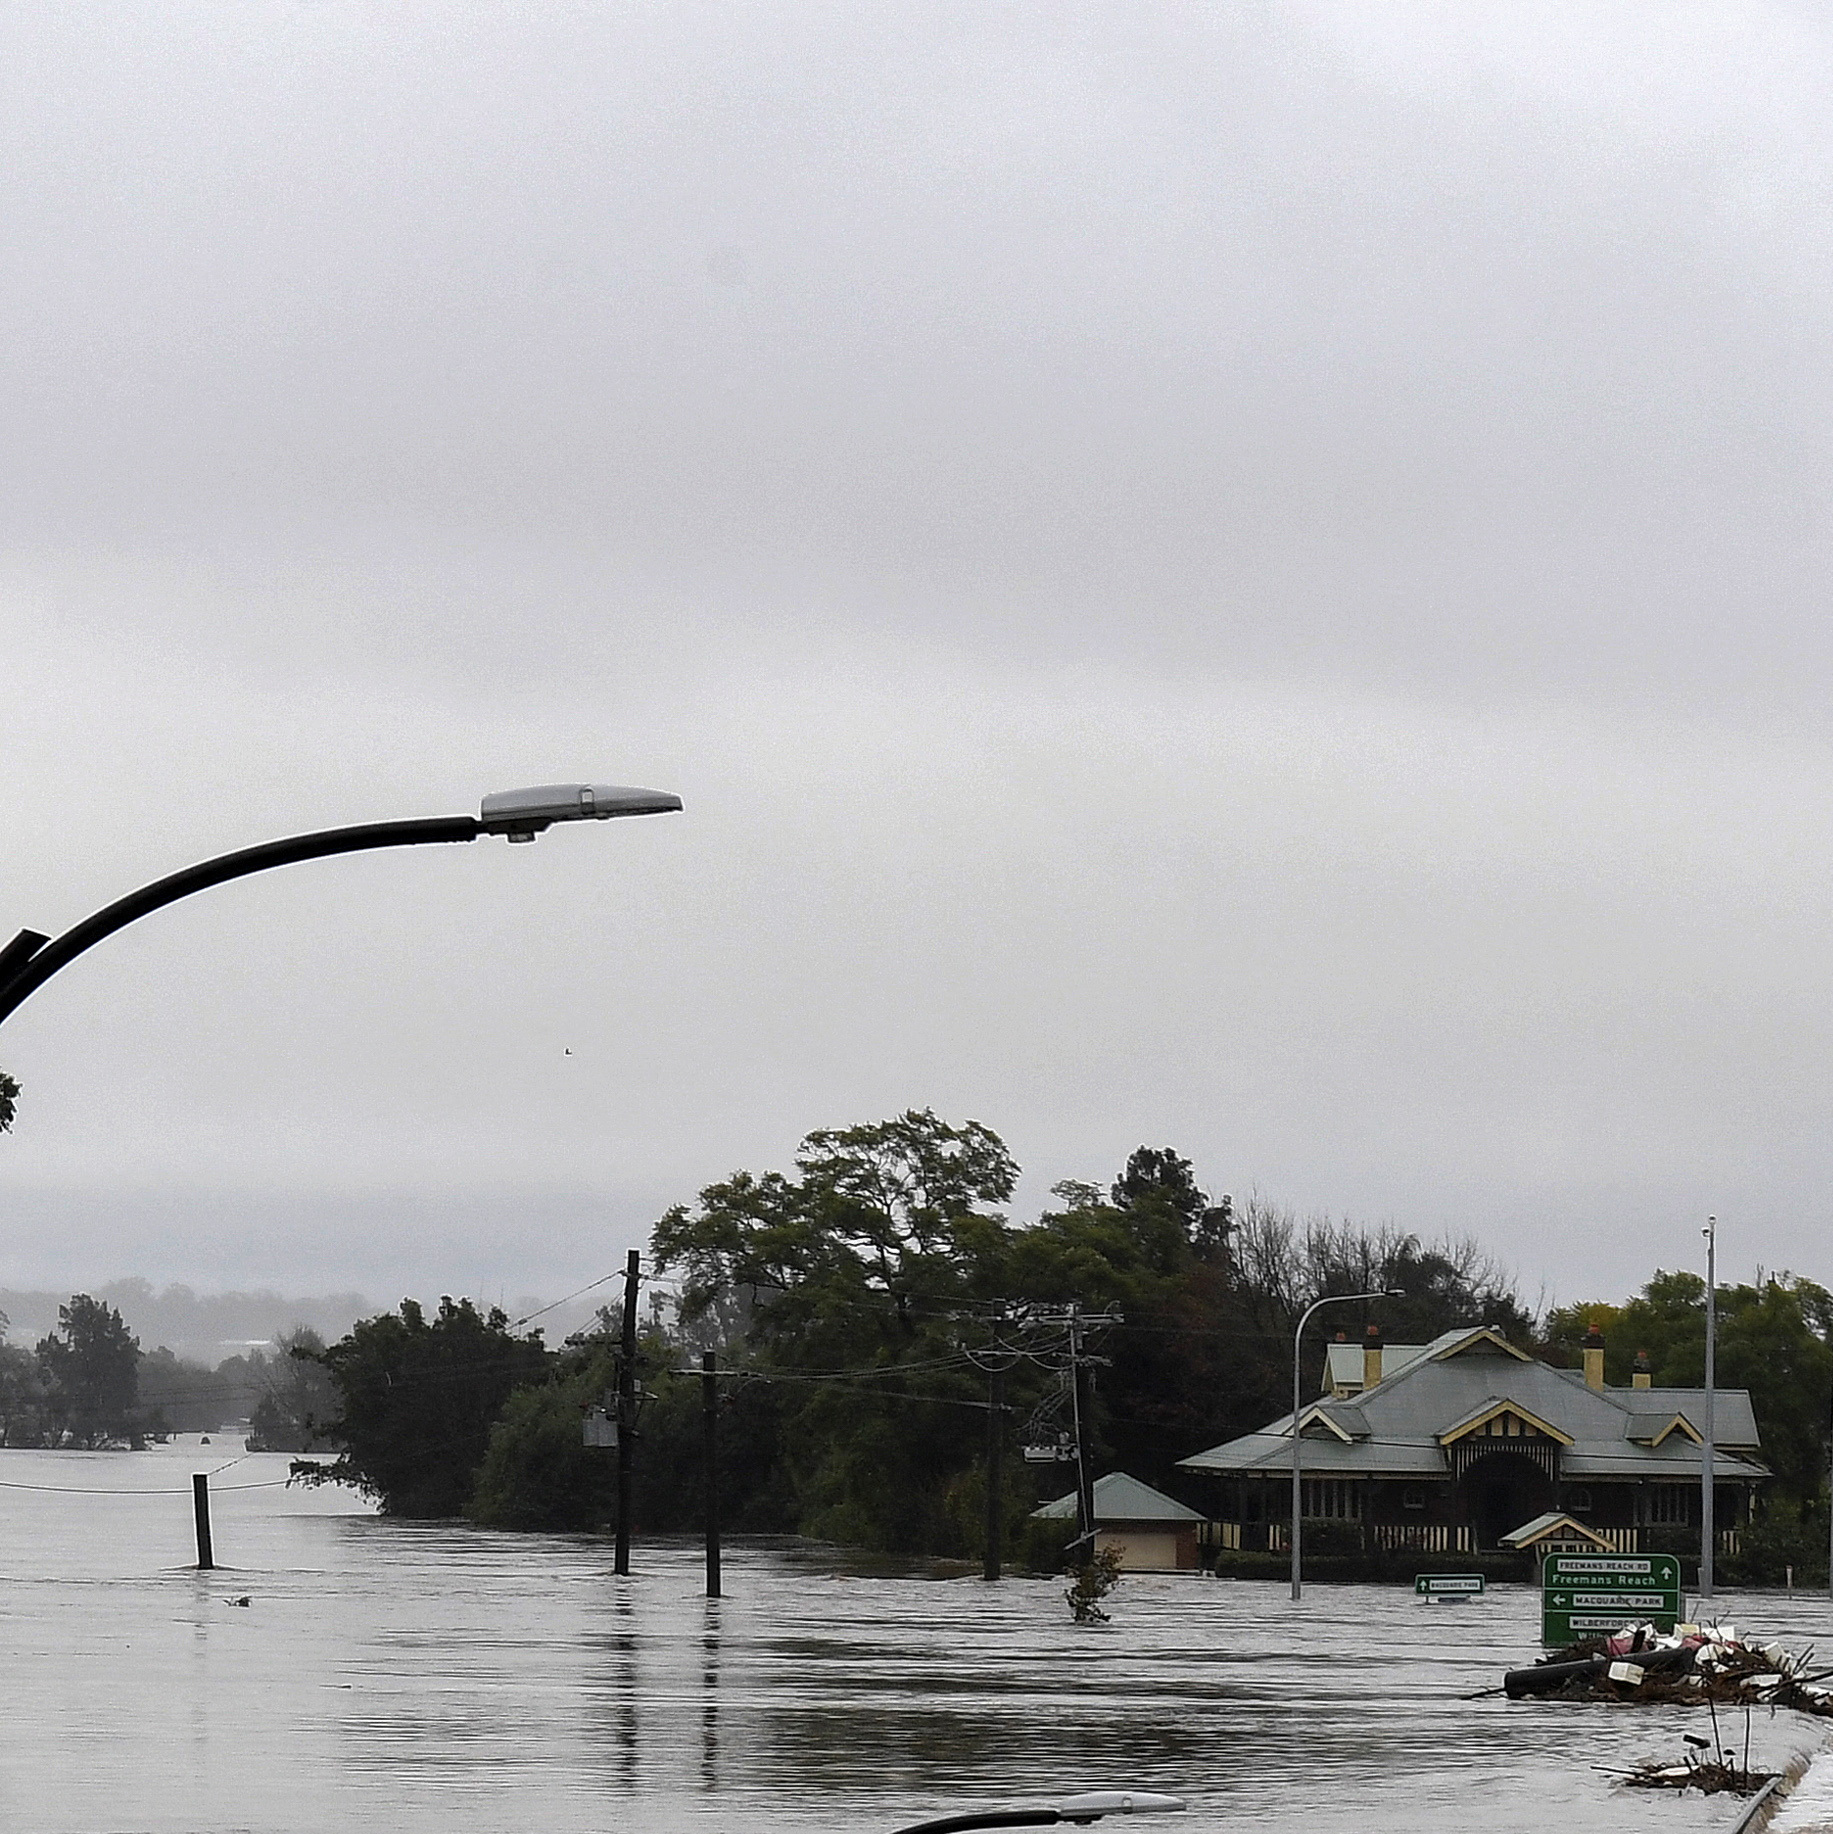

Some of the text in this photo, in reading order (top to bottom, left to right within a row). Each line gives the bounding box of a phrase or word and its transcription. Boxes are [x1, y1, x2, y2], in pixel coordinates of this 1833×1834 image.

[1560, 1561, 1649, 1571] FREEMANS REACH RD
[1552, 1574, 1656, 1585] Freemans Reach
[1635, 1597, 1662, 1606] PARK
